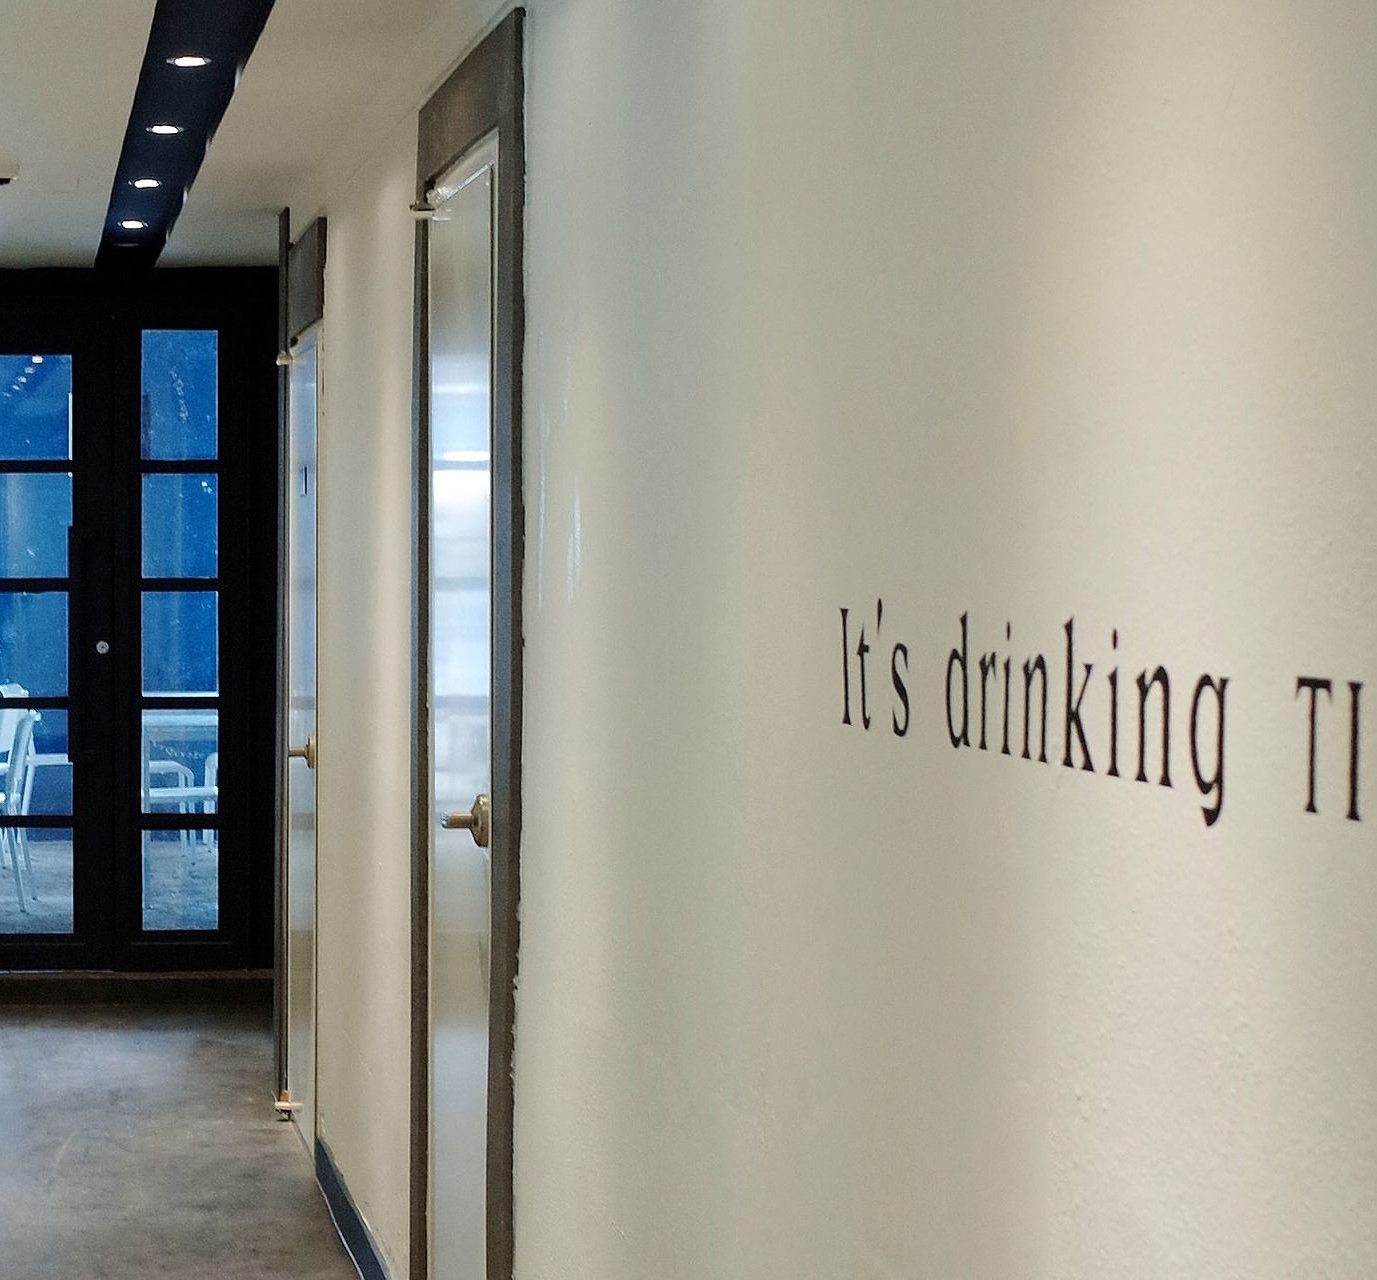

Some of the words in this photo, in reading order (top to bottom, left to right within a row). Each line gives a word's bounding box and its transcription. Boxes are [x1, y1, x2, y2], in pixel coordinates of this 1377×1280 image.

[838, 598, 910, 739] It's
[940, 611, 1231, 828] drinking
[1294, 677, 1364, 823] TI
